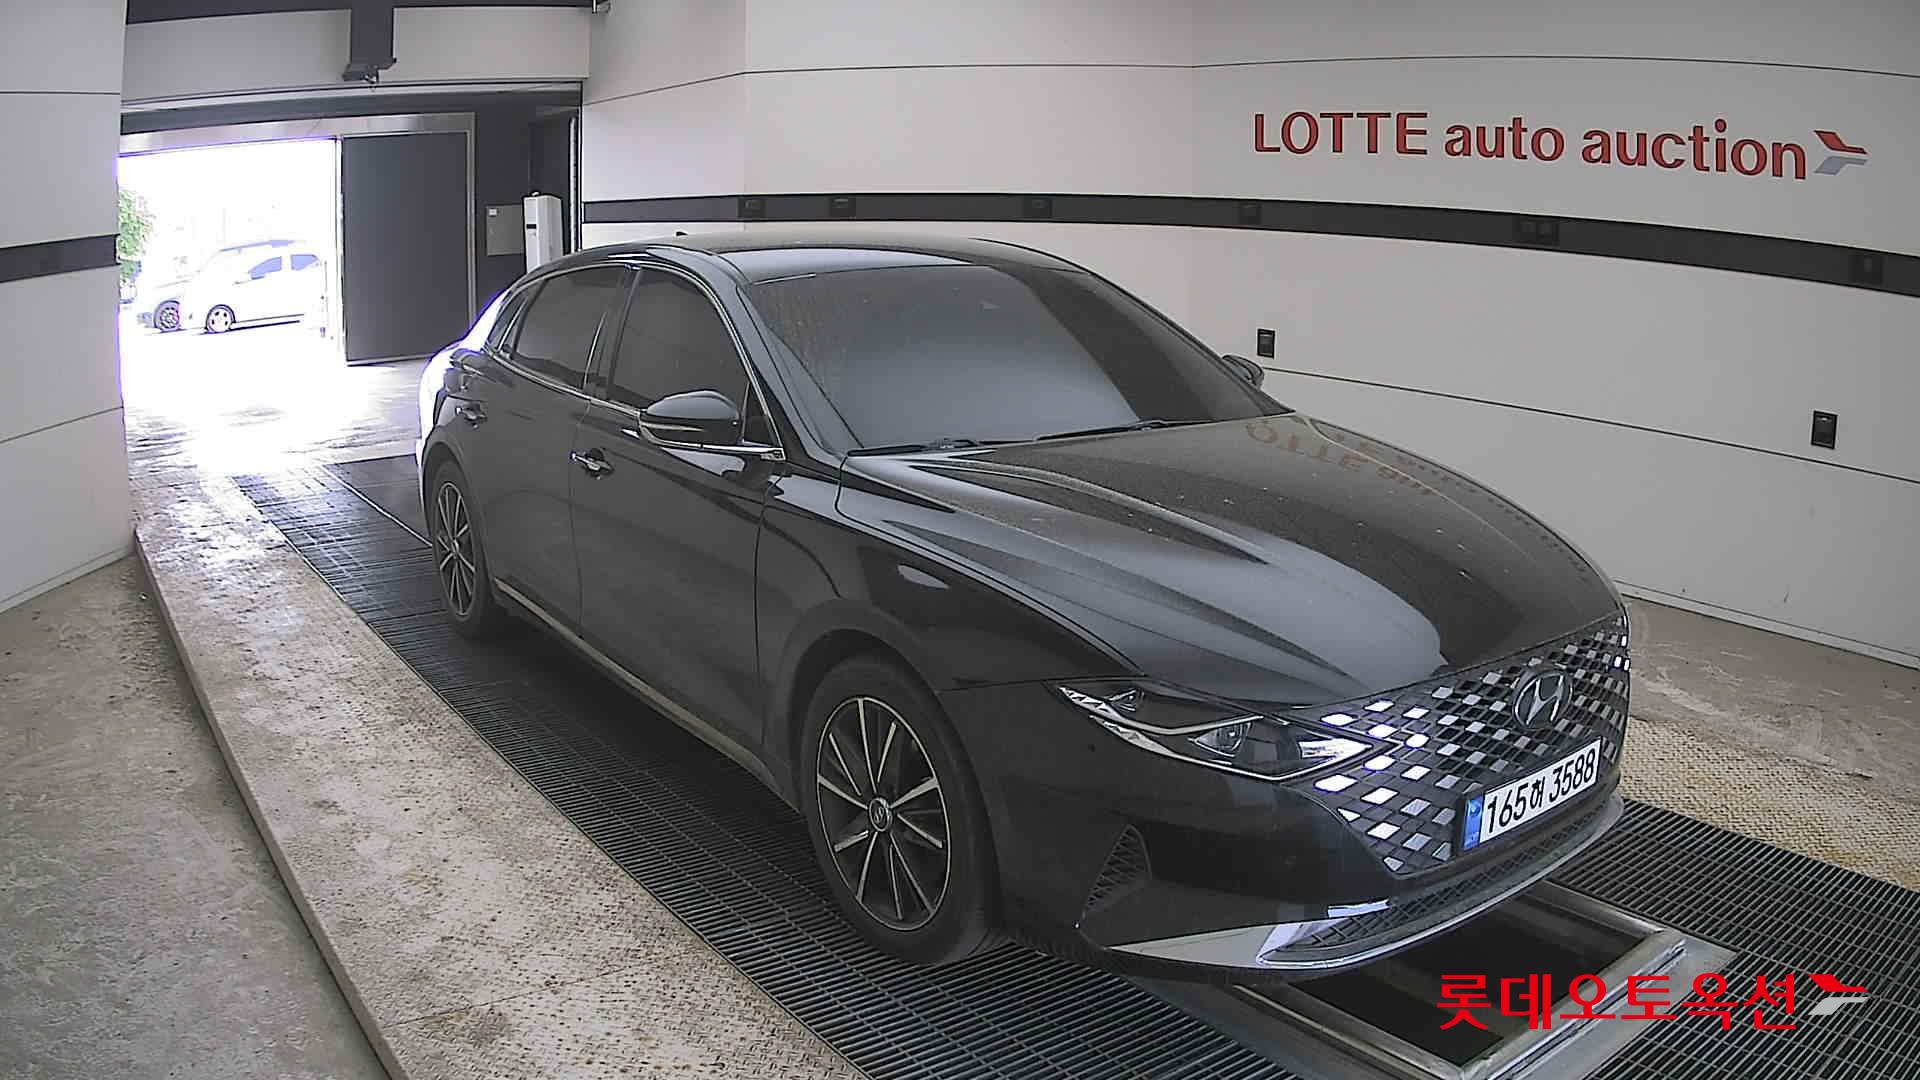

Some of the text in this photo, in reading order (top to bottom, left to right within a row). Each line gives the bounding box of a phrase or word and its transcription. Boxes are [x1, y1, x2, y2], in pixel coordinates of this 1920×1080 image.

[1254, 111, 1808, 180] LOTTE auto auction
[1549, 748, 1596, 803] 3588
